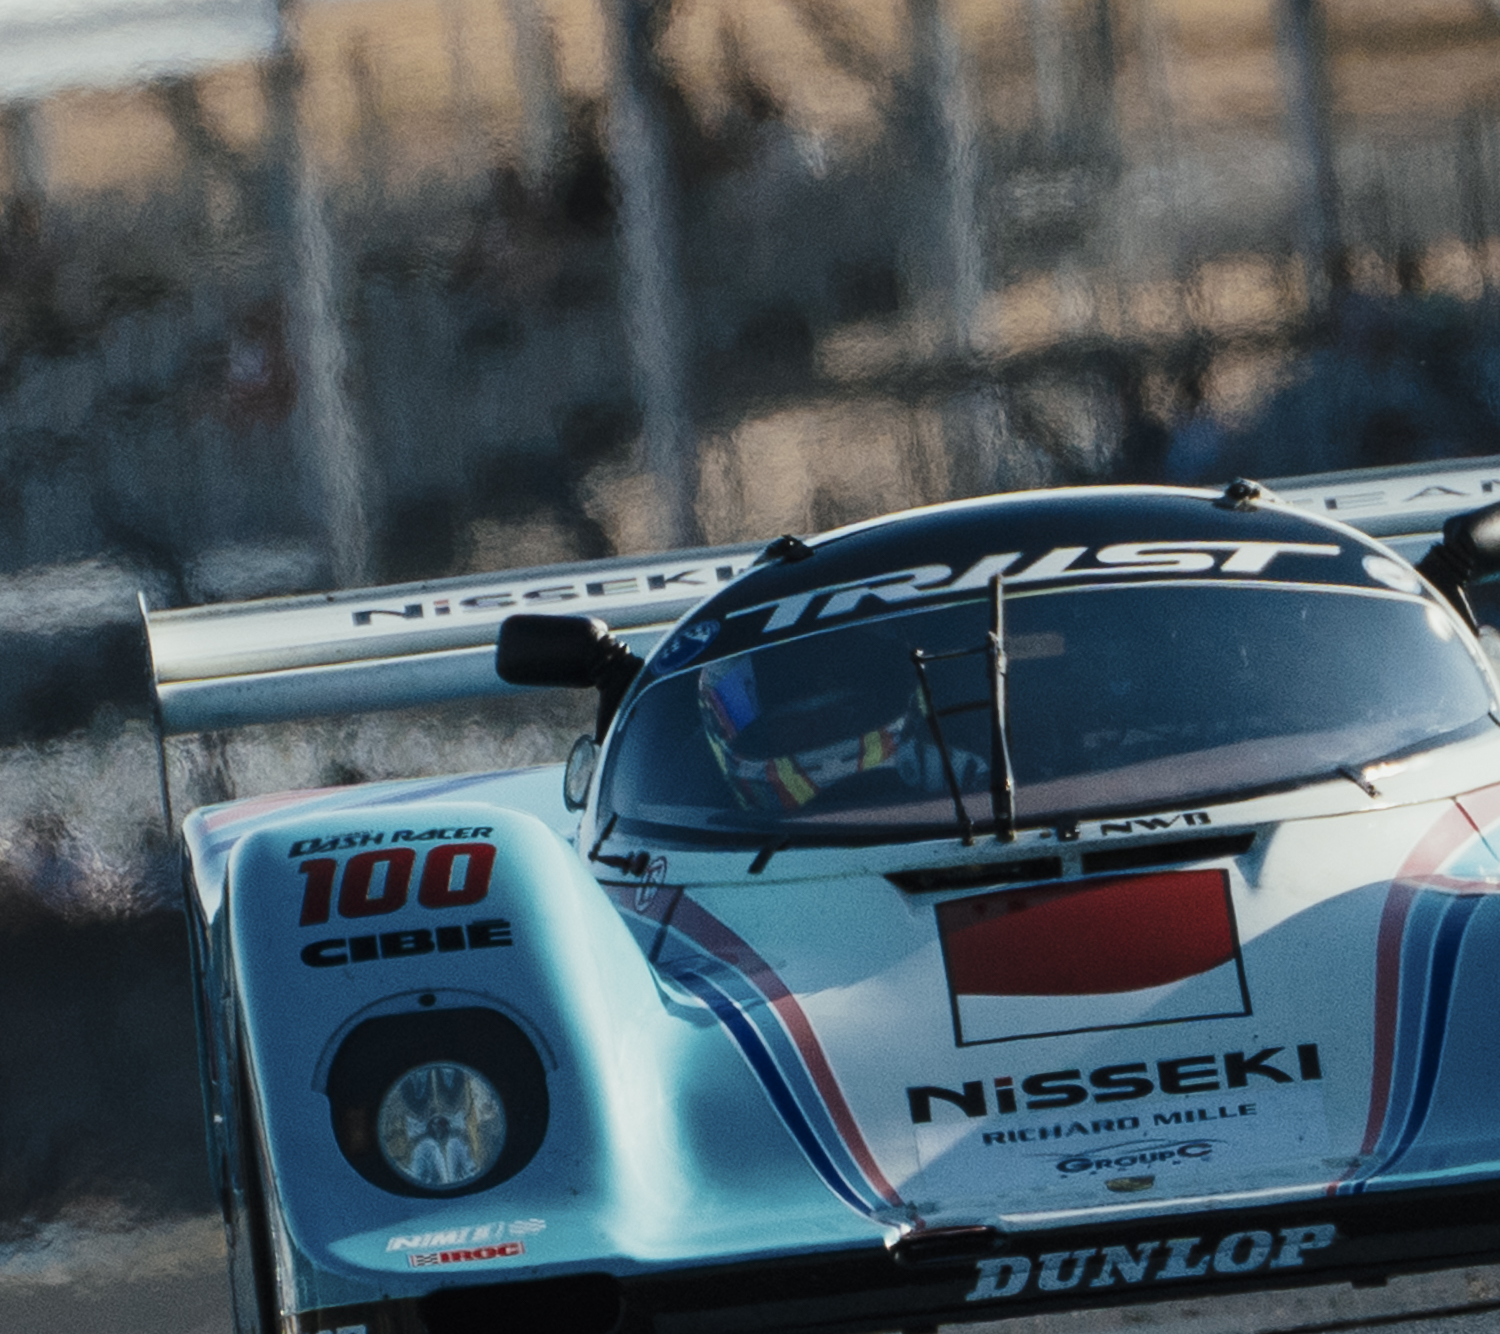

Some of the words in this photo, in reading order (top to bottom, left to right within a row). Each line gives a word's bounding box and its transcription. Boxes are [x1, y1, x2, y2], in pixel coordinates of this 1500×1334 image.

[726, 541, 1341, 633] TRUST
[288, 832, 385, 859] DASH
[391, 826, 494, 844] RACER
[298, 842, 498, 928] 100
[982, 1115, 1140, 1147] RICHARD
[1153, 1102, 1257, 1128] MILLE
[965, 1223, 1336, 1302] DUNLOP
